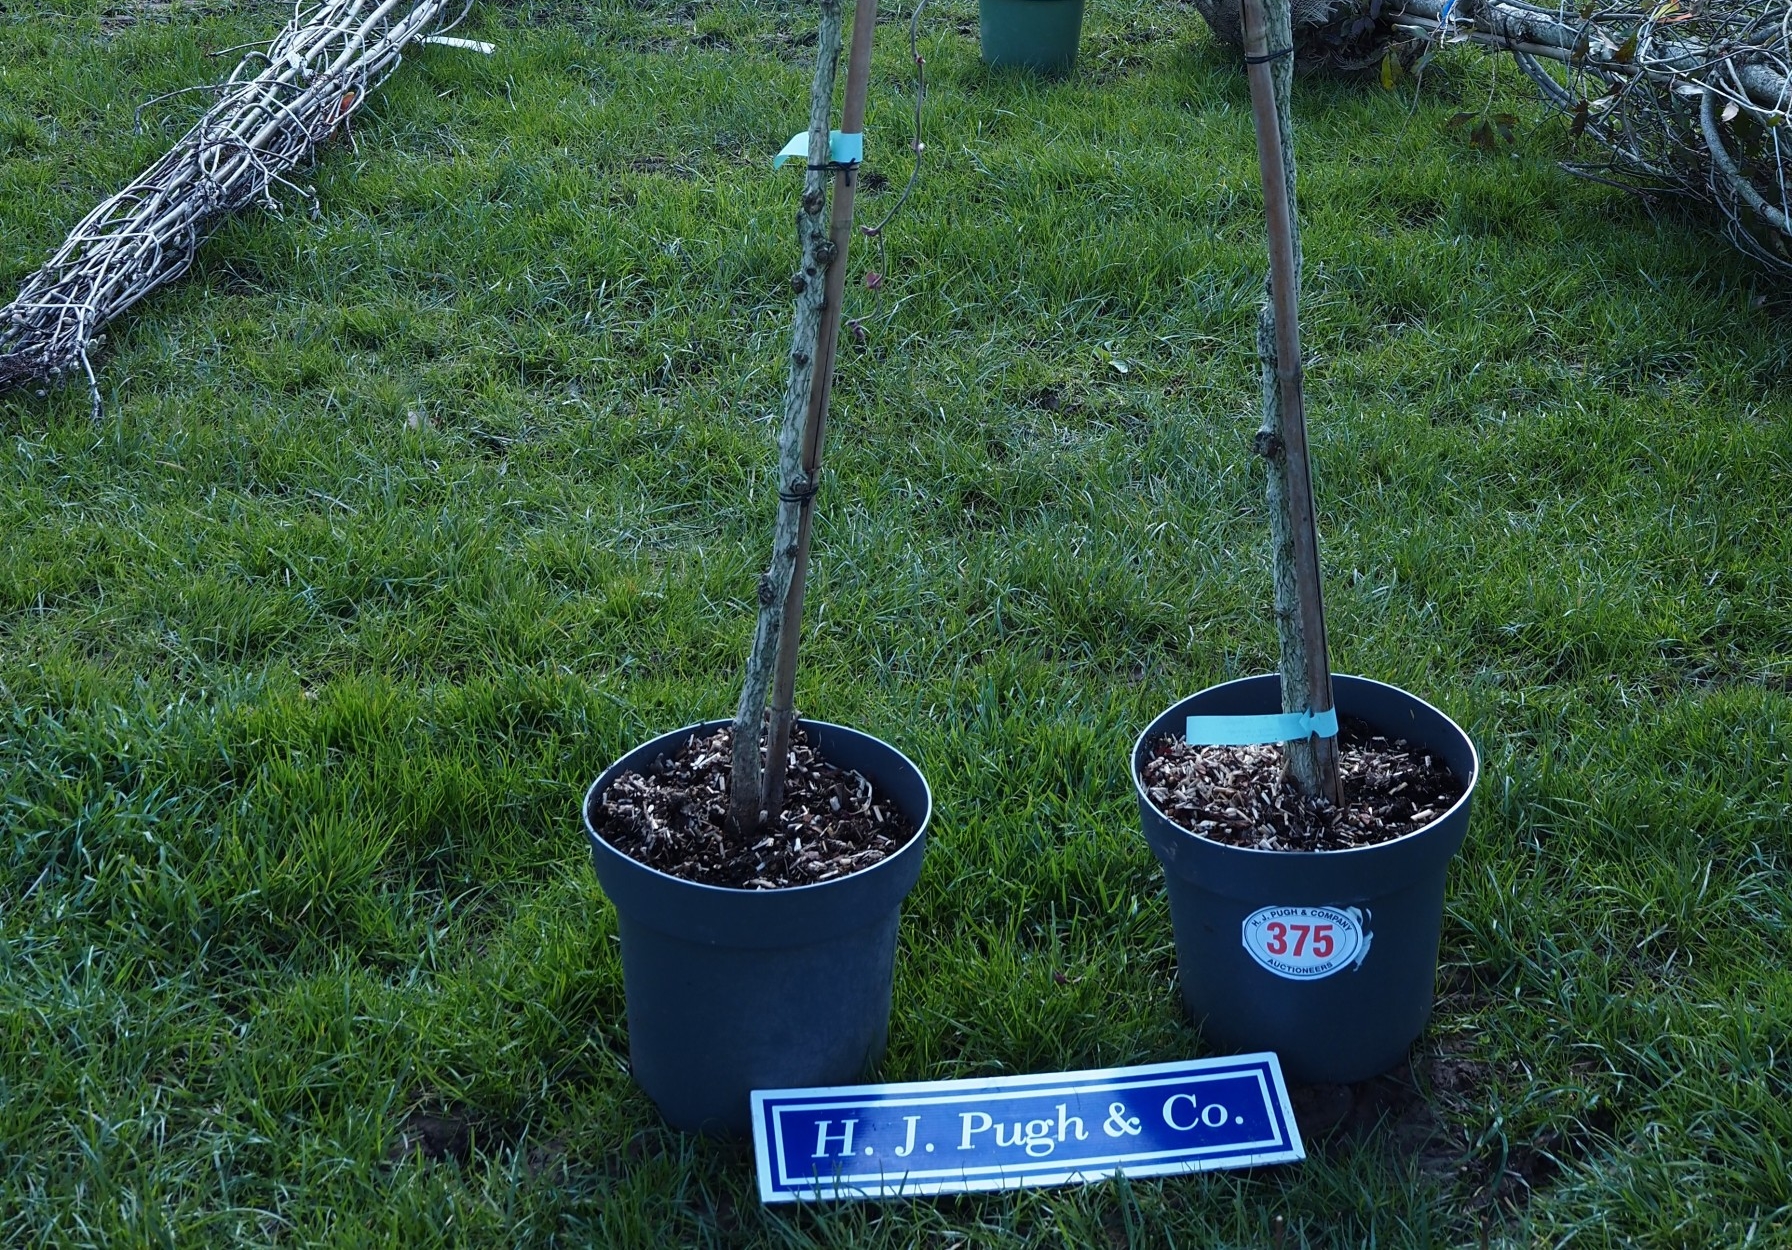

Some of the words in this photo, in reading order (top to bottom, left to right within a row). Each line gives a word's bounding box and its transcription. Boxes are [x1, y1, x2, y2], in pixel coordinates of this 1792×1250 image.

[1251, 919, 1262, 927] H.
[1270, 909, 1298, 918] PUGH
[1310, 909, 1353, 931] COMPANY
[1267, 922, 1334, 958] 375
[1267, 958, 1334, 974] AUCTIONEERS
[811, 1119, 875, 1159] H.
[894, 1115, 935, 1158] J.
[956, 1102, 1090, 1158] Pugh
[1102, 1102, 1142, 1138] &
[1162, 1094, 1245, 1131] Co.
